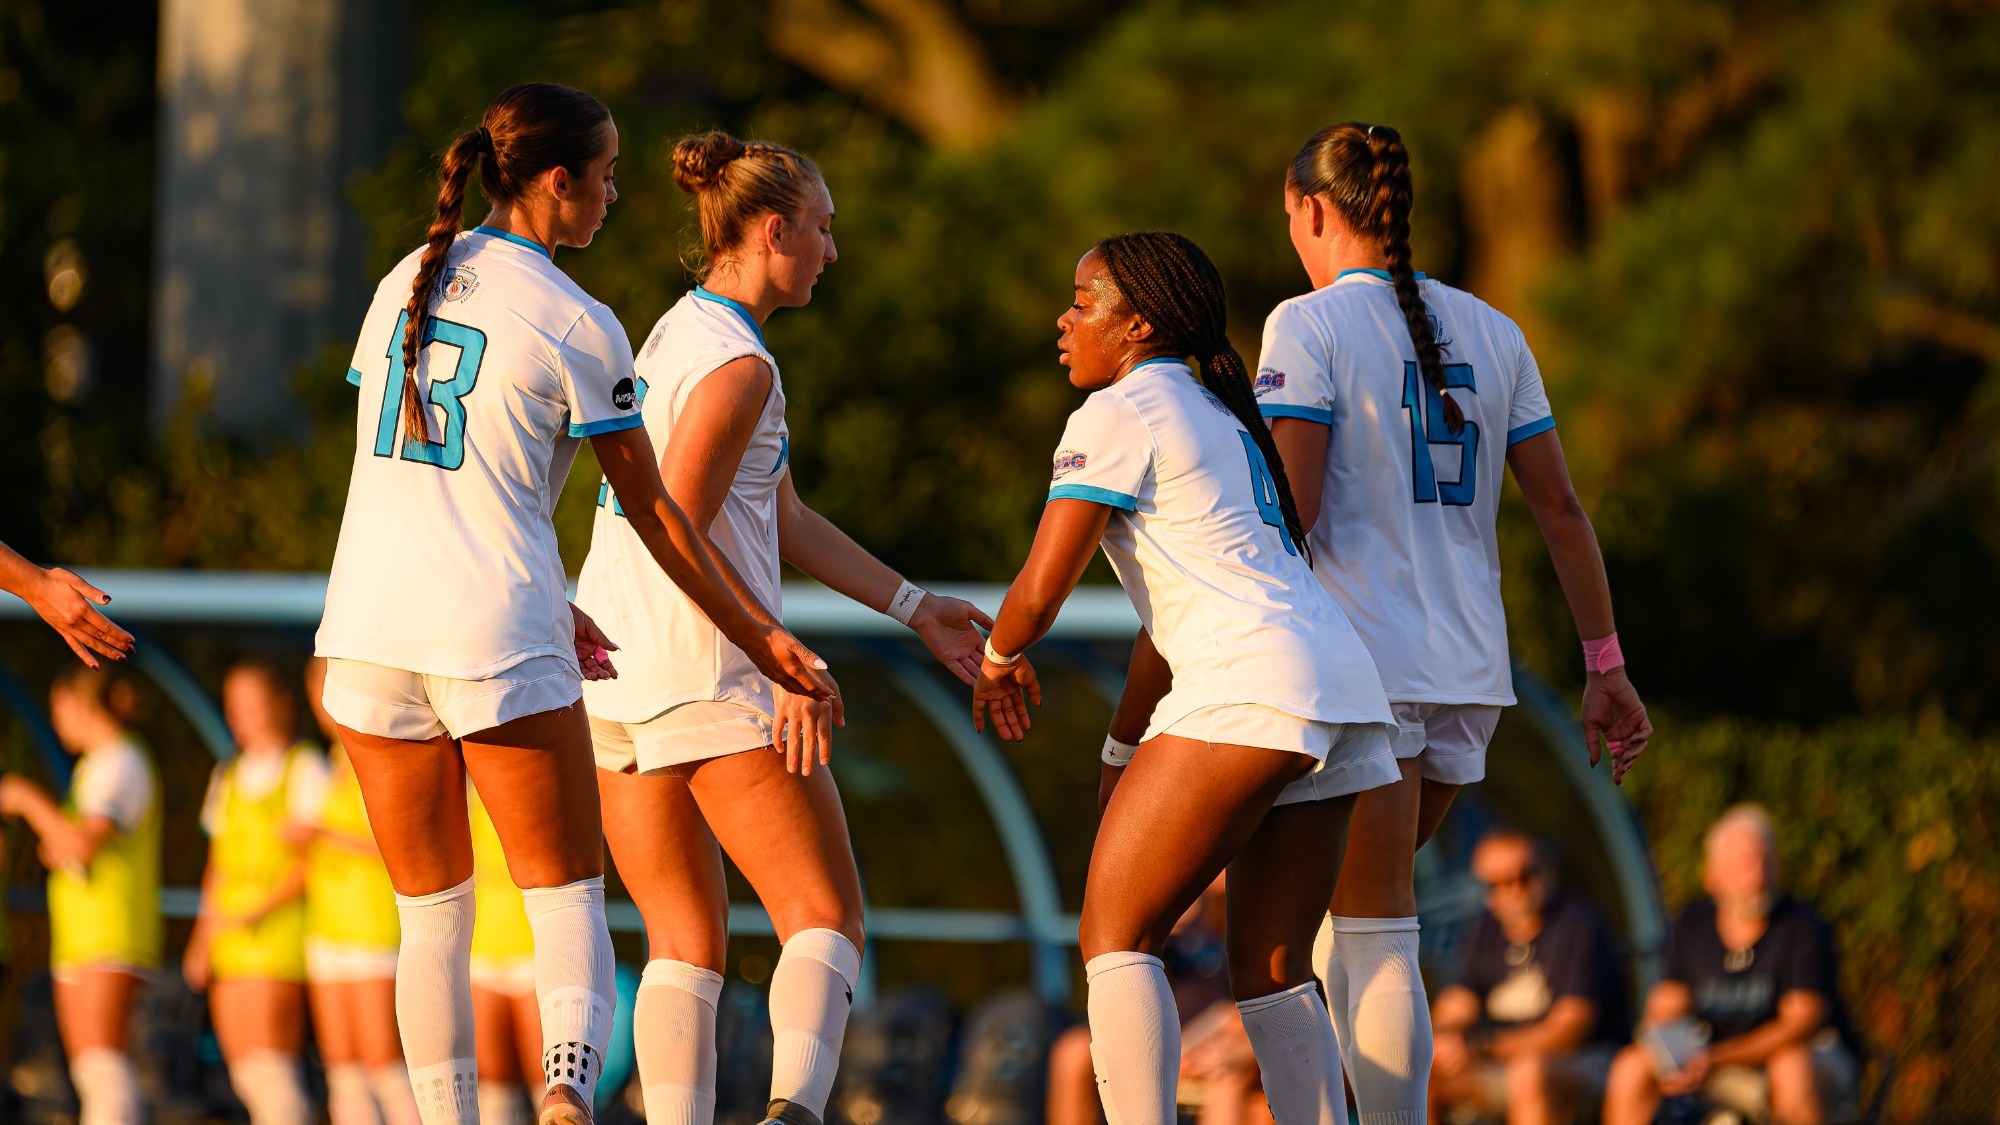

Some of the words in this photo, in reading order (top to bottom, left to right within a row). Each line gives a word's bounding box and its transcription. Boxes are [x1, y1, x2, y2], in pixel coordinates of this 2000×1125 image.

[374, 308, 488, 471] 13
[1401, 360, 1478, 506] 15
[1237, 429, 1298, 557] 4
